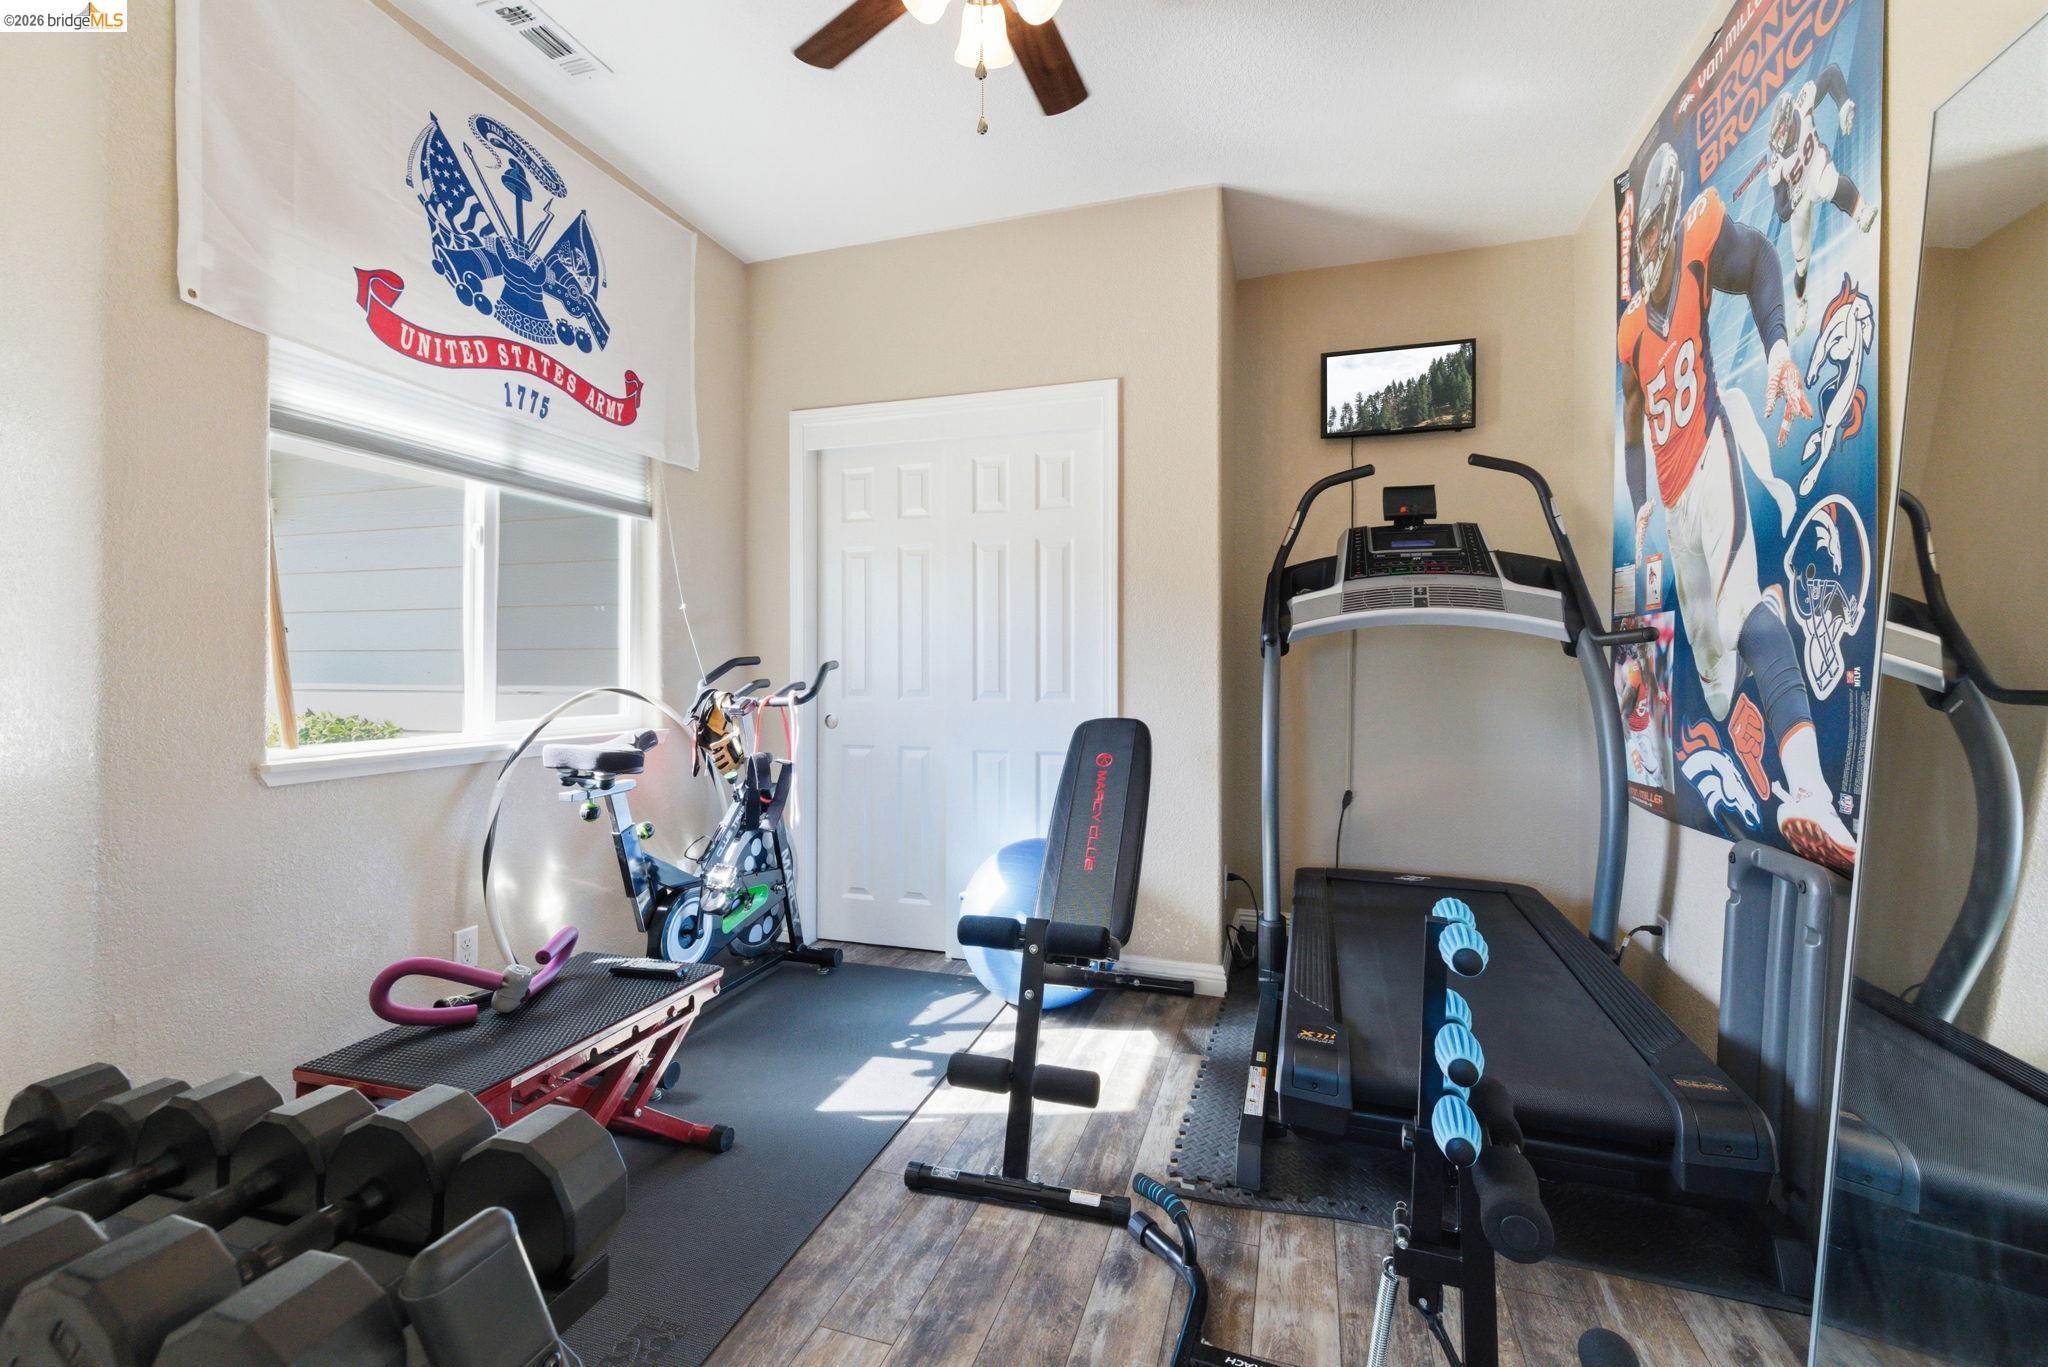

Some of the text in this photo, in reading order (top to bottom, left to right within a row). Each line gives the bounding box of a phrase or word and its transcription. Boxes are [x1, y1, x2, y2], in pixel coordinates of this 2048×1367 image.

[1697, 46, 1723, 89] VON
[1700, 0, 1854, 185] BRONCO
[400, 323, 625, 423] UNITED STATES ARMY
[504, 382, 550, 420] 1775
[1647, 338, 1697, 446] 58
[1091, 769, 1108, 823] MARCY
[781, 848, 800, 923] MARCY
